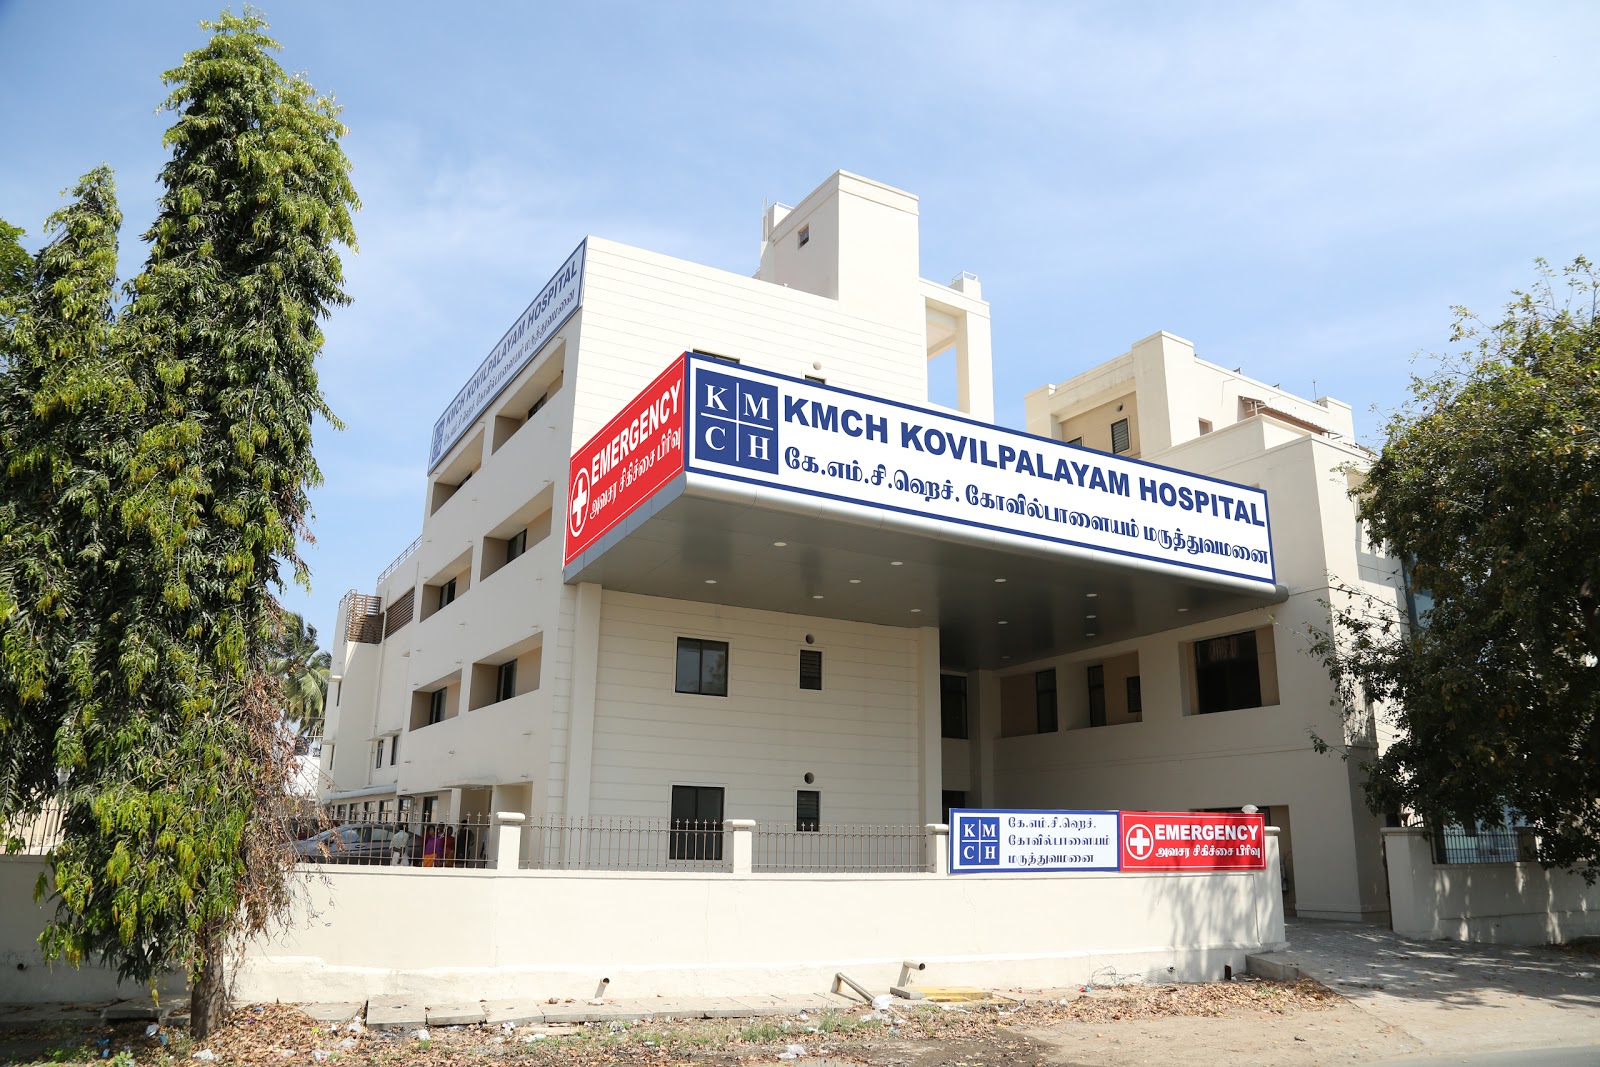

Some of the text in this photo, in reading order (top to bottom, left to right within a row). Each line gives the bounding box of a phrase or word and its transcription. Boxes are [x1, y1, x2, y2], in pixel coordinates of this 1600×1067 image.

[528, 260, 577, 330] HOSPITAL
[591, 379, 682, 486] EMERGENCY
[784, 395, 1265, 527] KMCH KOVILPALAYAM HOSPITAL
[590, 427, 682, 520] அவசர சிகிச்சை பிரிவு
[784, 446, 1268, 565] கே.எம்.சி.ஹெச். கோவில்பாளையம் மருத்துவமனை
[1008, 834, 1111, 847] கோவில்பாளையம்
[1008, 852, 1095, 867] மருத்துவமனை
[1155, 824, 1260, 841] EMERGENCY
[1155, 844, 1261, 859] அவசர சிகிச்சை பிரிவு
